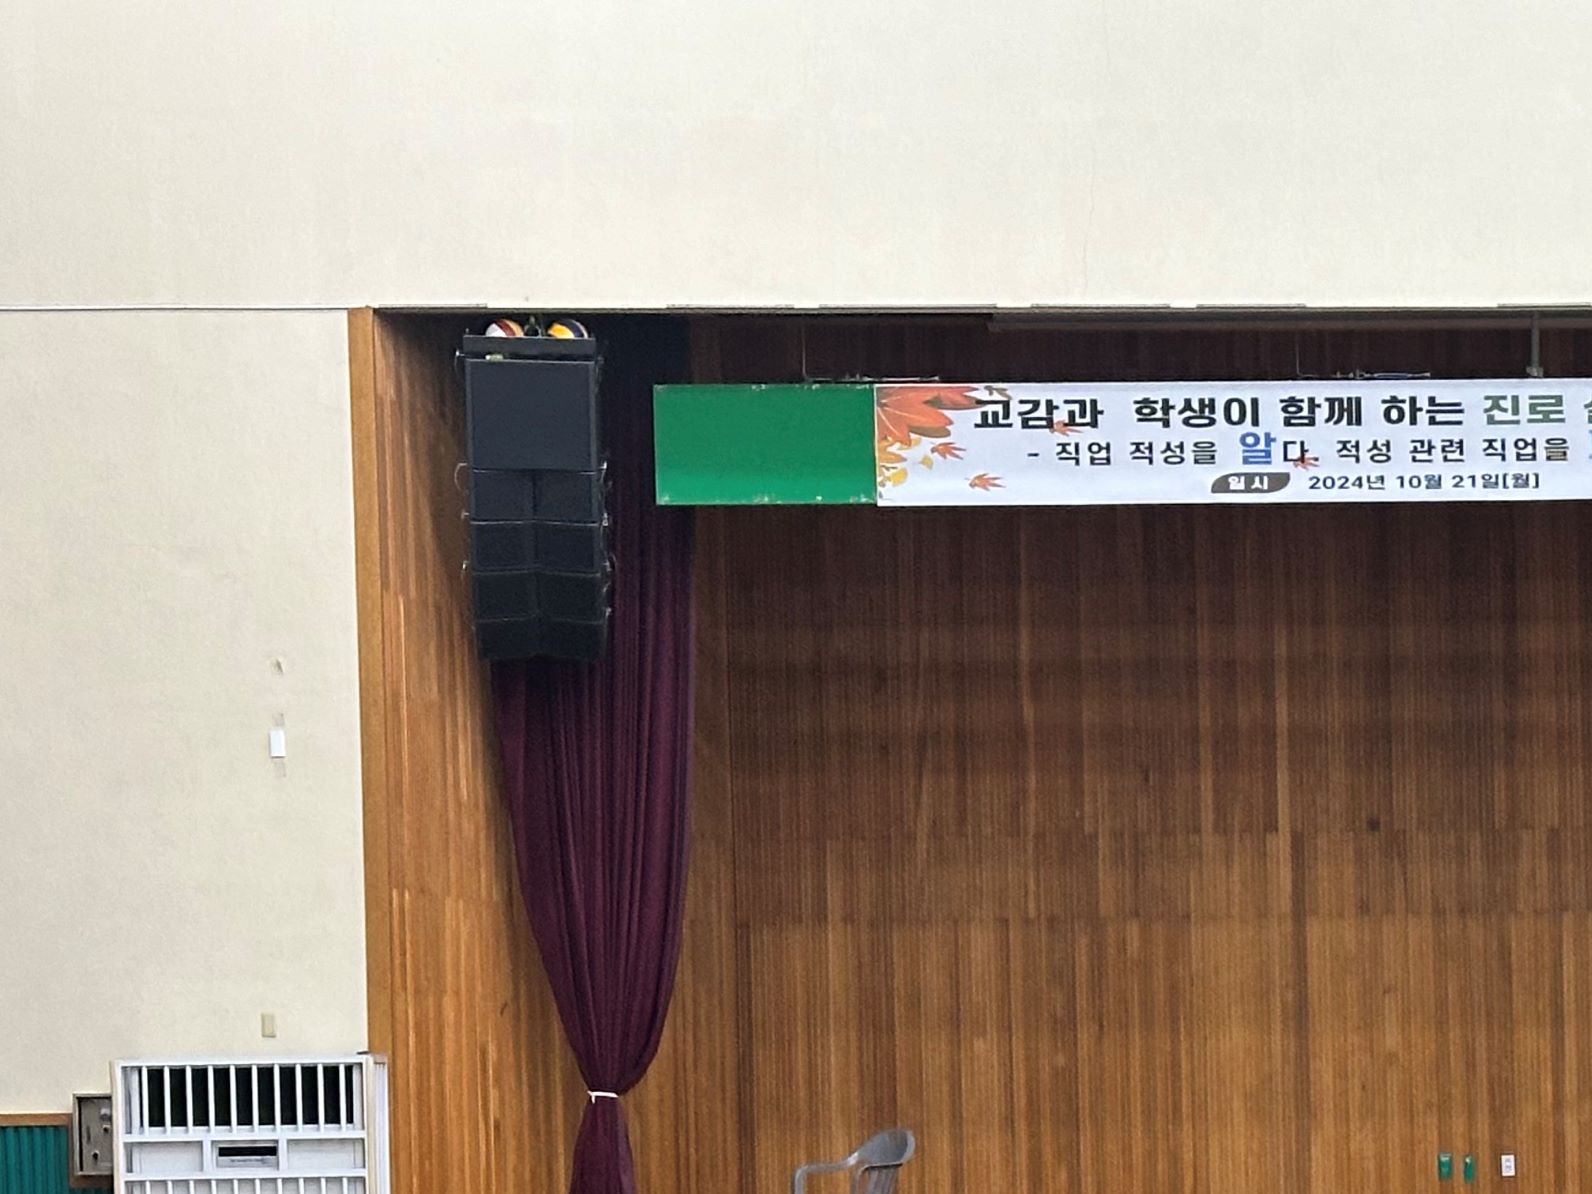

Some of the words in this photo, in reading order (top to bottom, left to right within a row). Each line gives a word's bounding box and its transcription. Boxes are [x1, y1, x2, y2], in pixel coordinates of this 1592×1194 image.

[973, 398, 1104, 430] 교감과
[1133, 396, 1260, 429] 학생이
[1279, 396, 1363, 427] 함께
[1381, 395, 1465, 426] 하는
[1483, 394, 1566, 426] 진로
[1056, 441, 1112, 466] 직업
[1129, 441, 1218, 465] 적성을
[1336, 439, 1392, 463] 적성
[1409, 438, 1465, 463] 관련
[1482, 437, 1570, 462] 직업을
[1227, 475, 1269, 490] 일시
[1308, 474, 1386, 490] 2024년
[1396, 474, 1443, 489] 10월
[1452, 473, 1540, 489] 21일[월]
